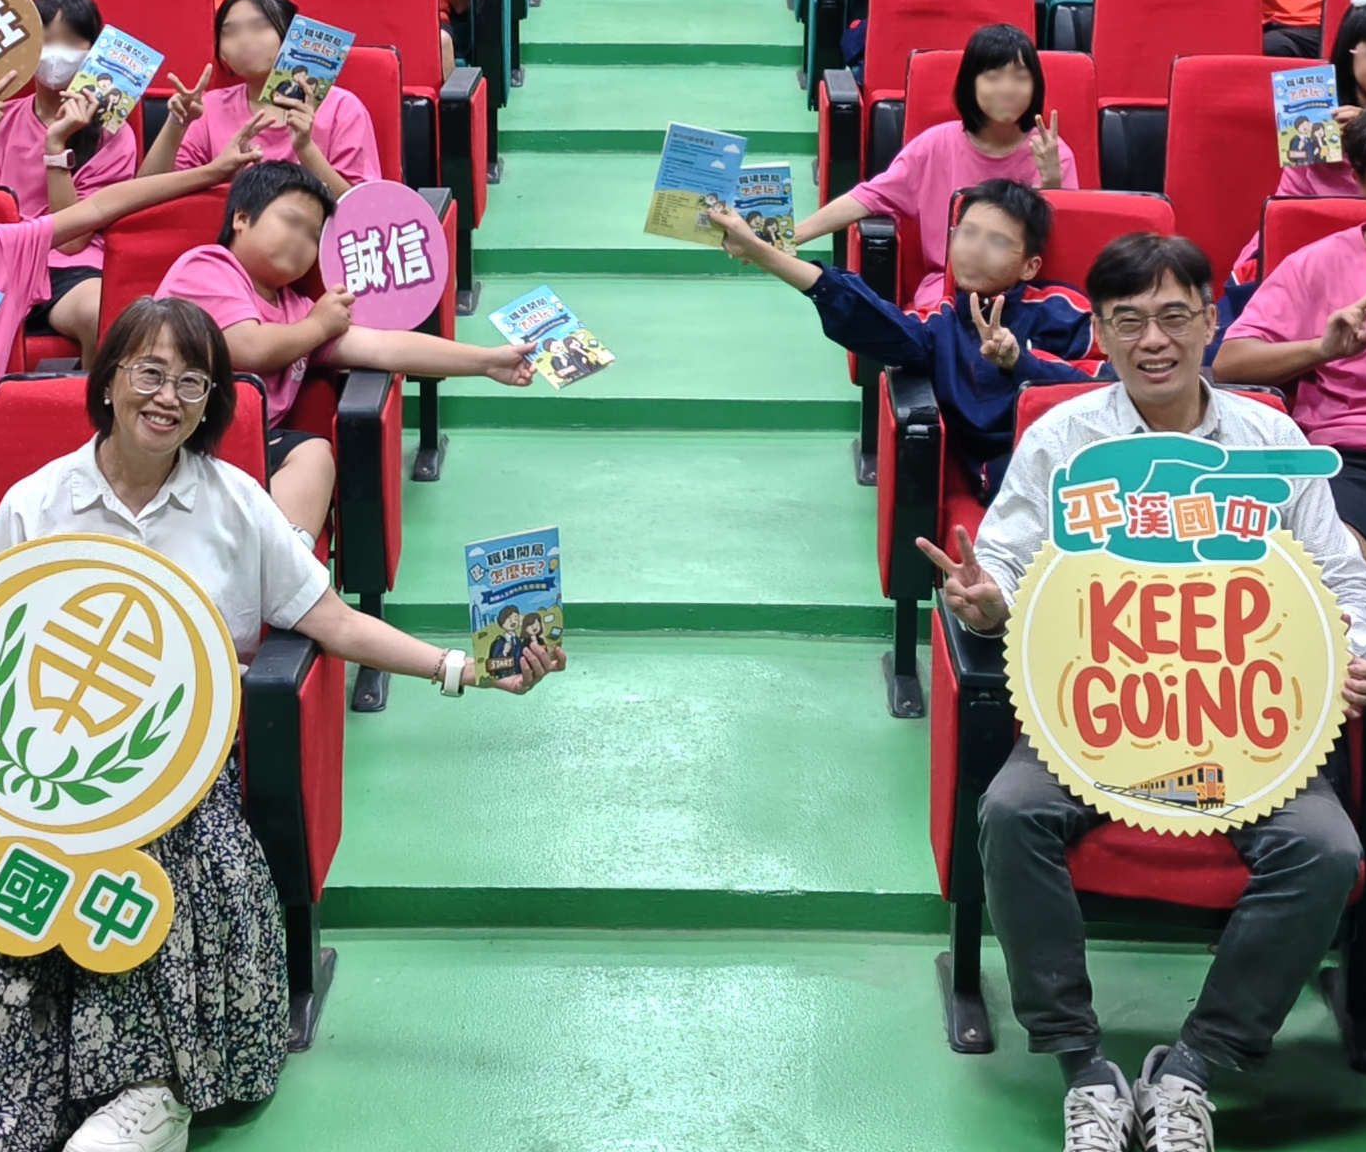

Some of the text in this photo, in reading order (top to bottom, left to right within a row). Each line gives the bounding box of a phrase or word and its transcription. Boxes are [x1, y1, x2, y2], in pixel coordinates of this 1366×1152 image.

[339, 222, 432, 294] 誠信
[1061, 482, 1269, 540] 平溪國中
[486, 544, 545, 566] 職場開局
[490, 561, 545, 585] 怎麼玩?
[1090, 577, 1271, 665] KEEP
[491, 659, 513, 669] START
